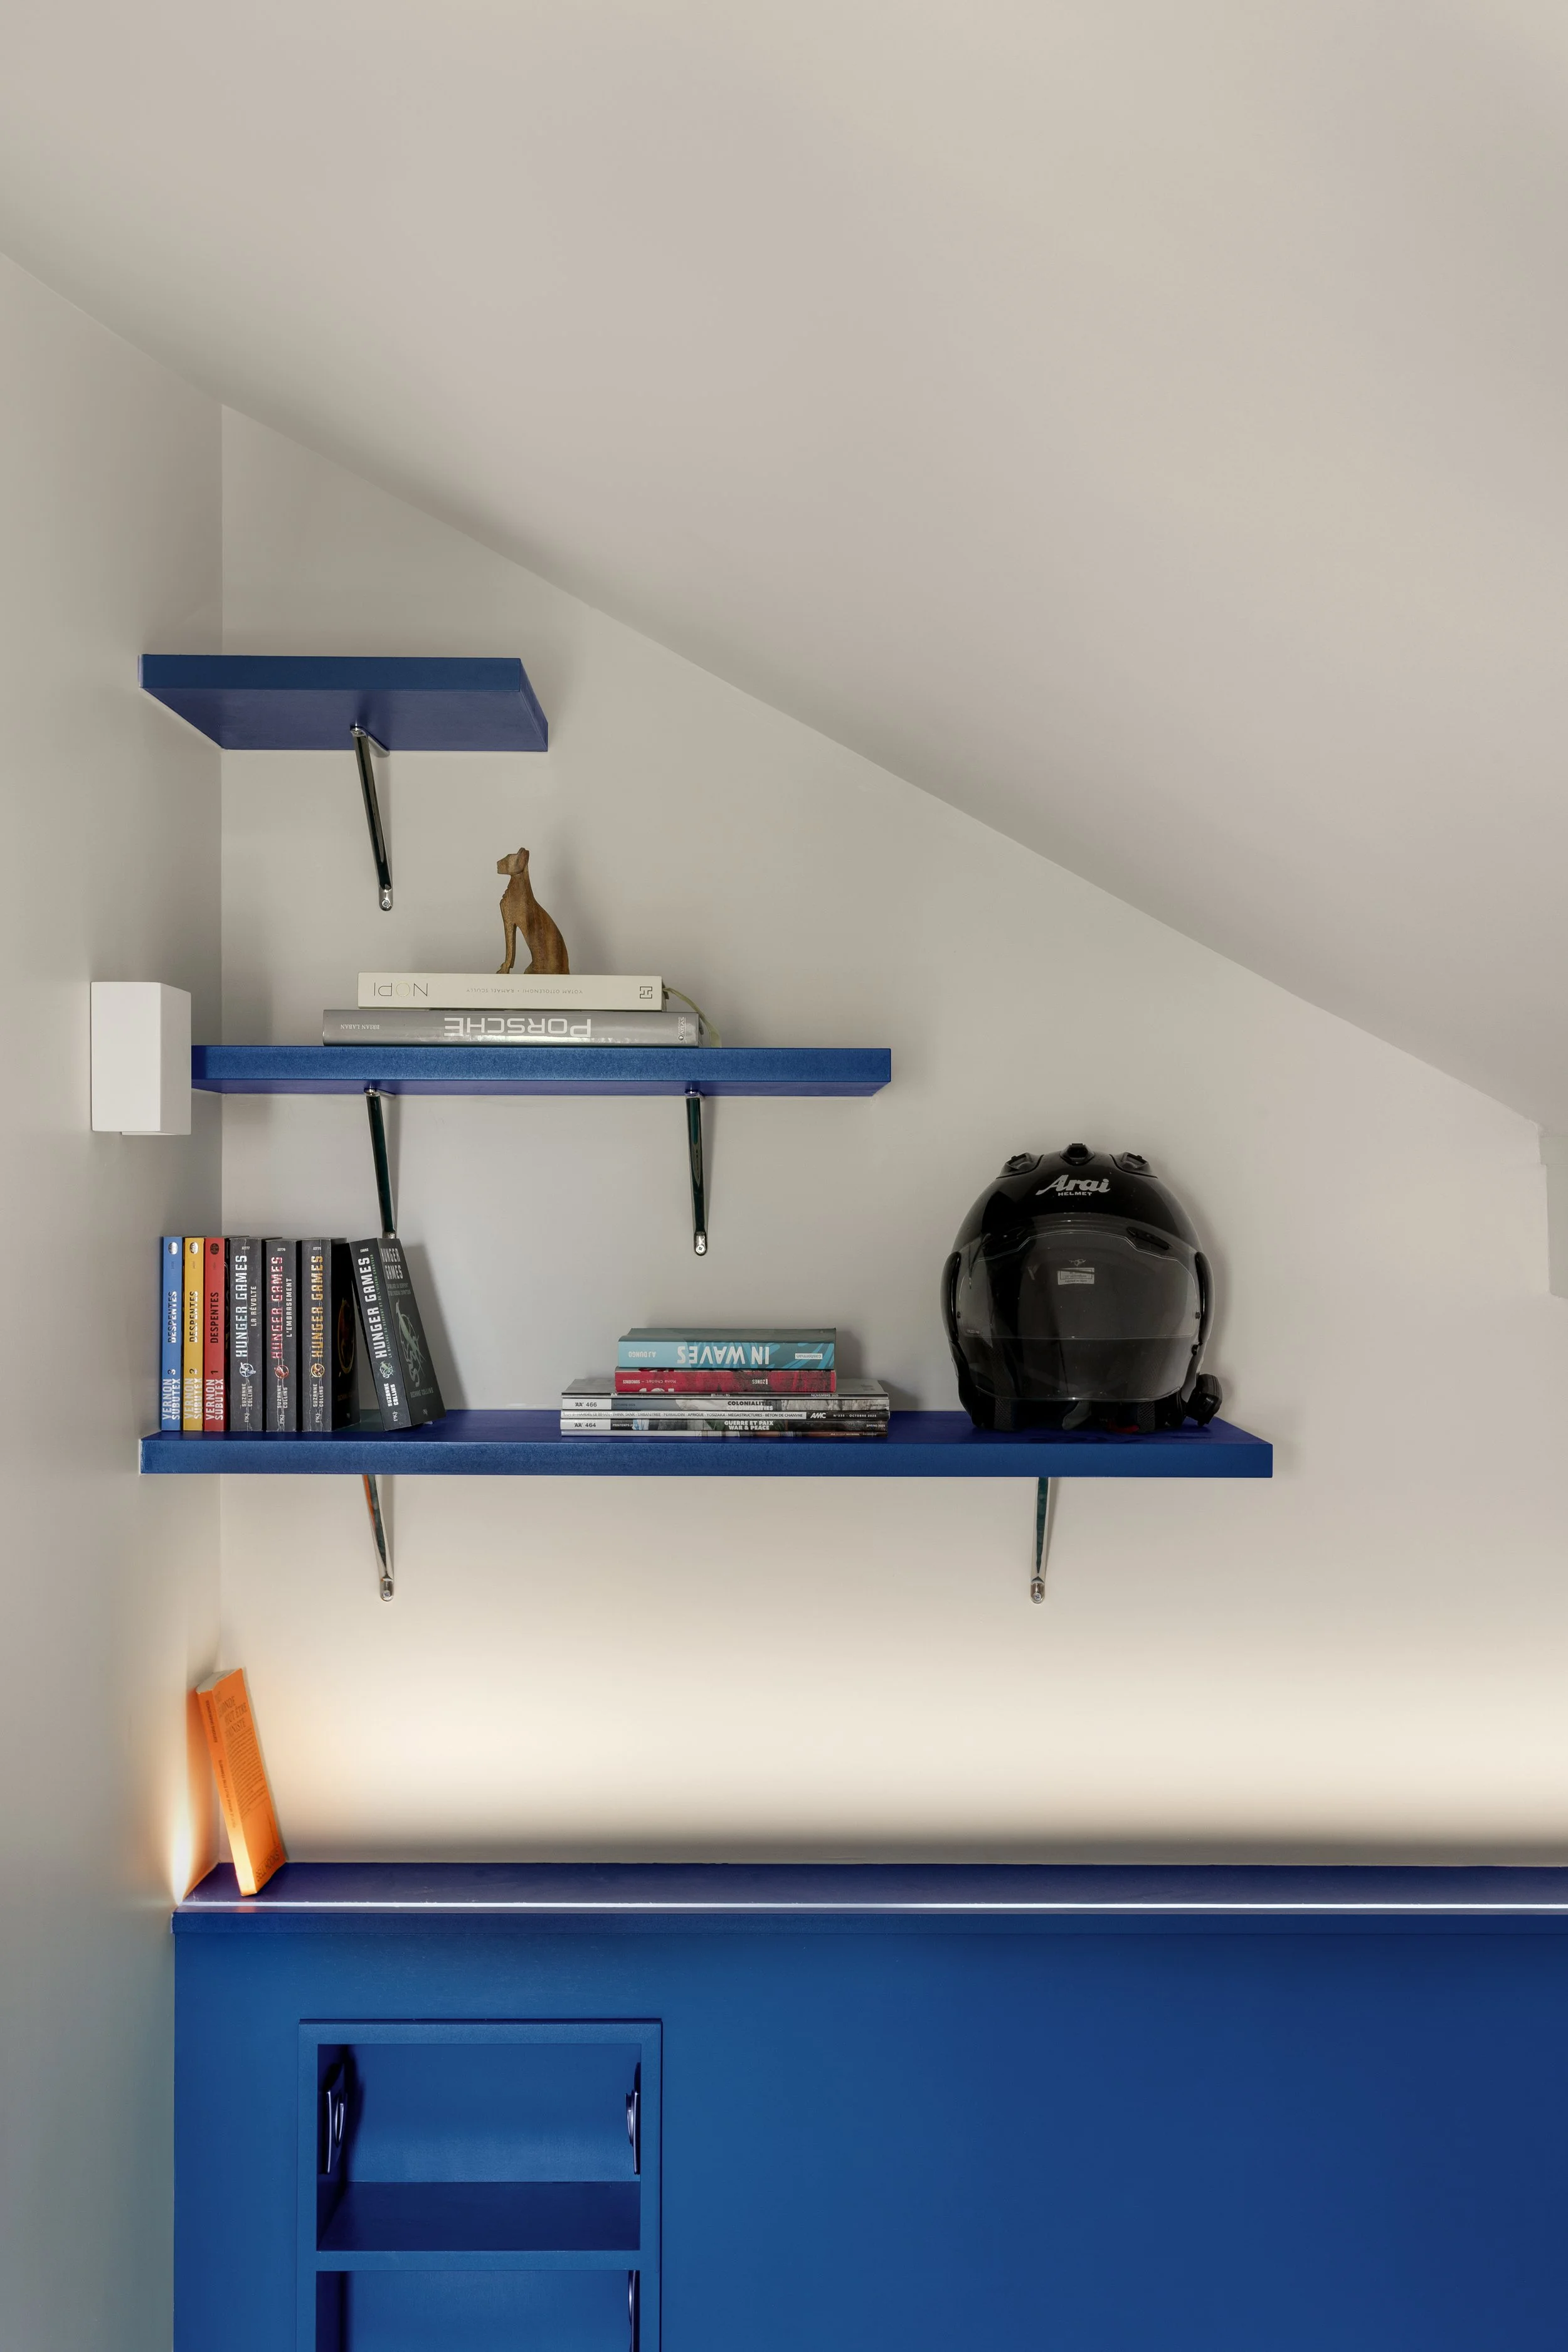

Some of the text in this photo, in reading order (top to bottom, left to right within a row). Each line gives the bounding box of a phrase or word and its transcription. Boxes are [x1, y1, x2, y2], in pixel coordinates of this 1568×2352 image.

[374, 982, 428, 998] NOPI
[444, 1017, 591, 1038] PORSCHE
[1036, 1175, 1111, 1195] Arai
[381, 1248, 401, 1263] HUNGER
[384, 1264, 403, 1279] GAMES
[168, 1291, 177, 1343] DESPENTES
[189, 1291, 198, 1343] DESPENTES
[210, 1292, 219, 1343] DESPENTES
[235, 1255, 248, 1358] HUNGER GAMES
[249, 1286, 257, 1327] LA RÉVOLTE
[271, 1257, 283, 1359] HUNGER GAMES
[310, 1256, 324, 1358] HUNGER GAMES
[358, 1257, 388, 1359] HUNGER GAMES
[677, 1346, 770, 1365] IN WAVES
[162, 1379, 172, 1420] VERNON
[171, 1378, 181, 1420] SUBUTEX
[184, 1378, 194, 1419] VERNON
[194, 1377, 203, 1419] SUBUTEX
[206, 1379, 215, 1420] VERNON
[215, 1379, 224, 1421] SUBUTEX
[383, 1382, 393, 1407] SUZANNE
[390, 1384, 398, 1406] COLLINS
